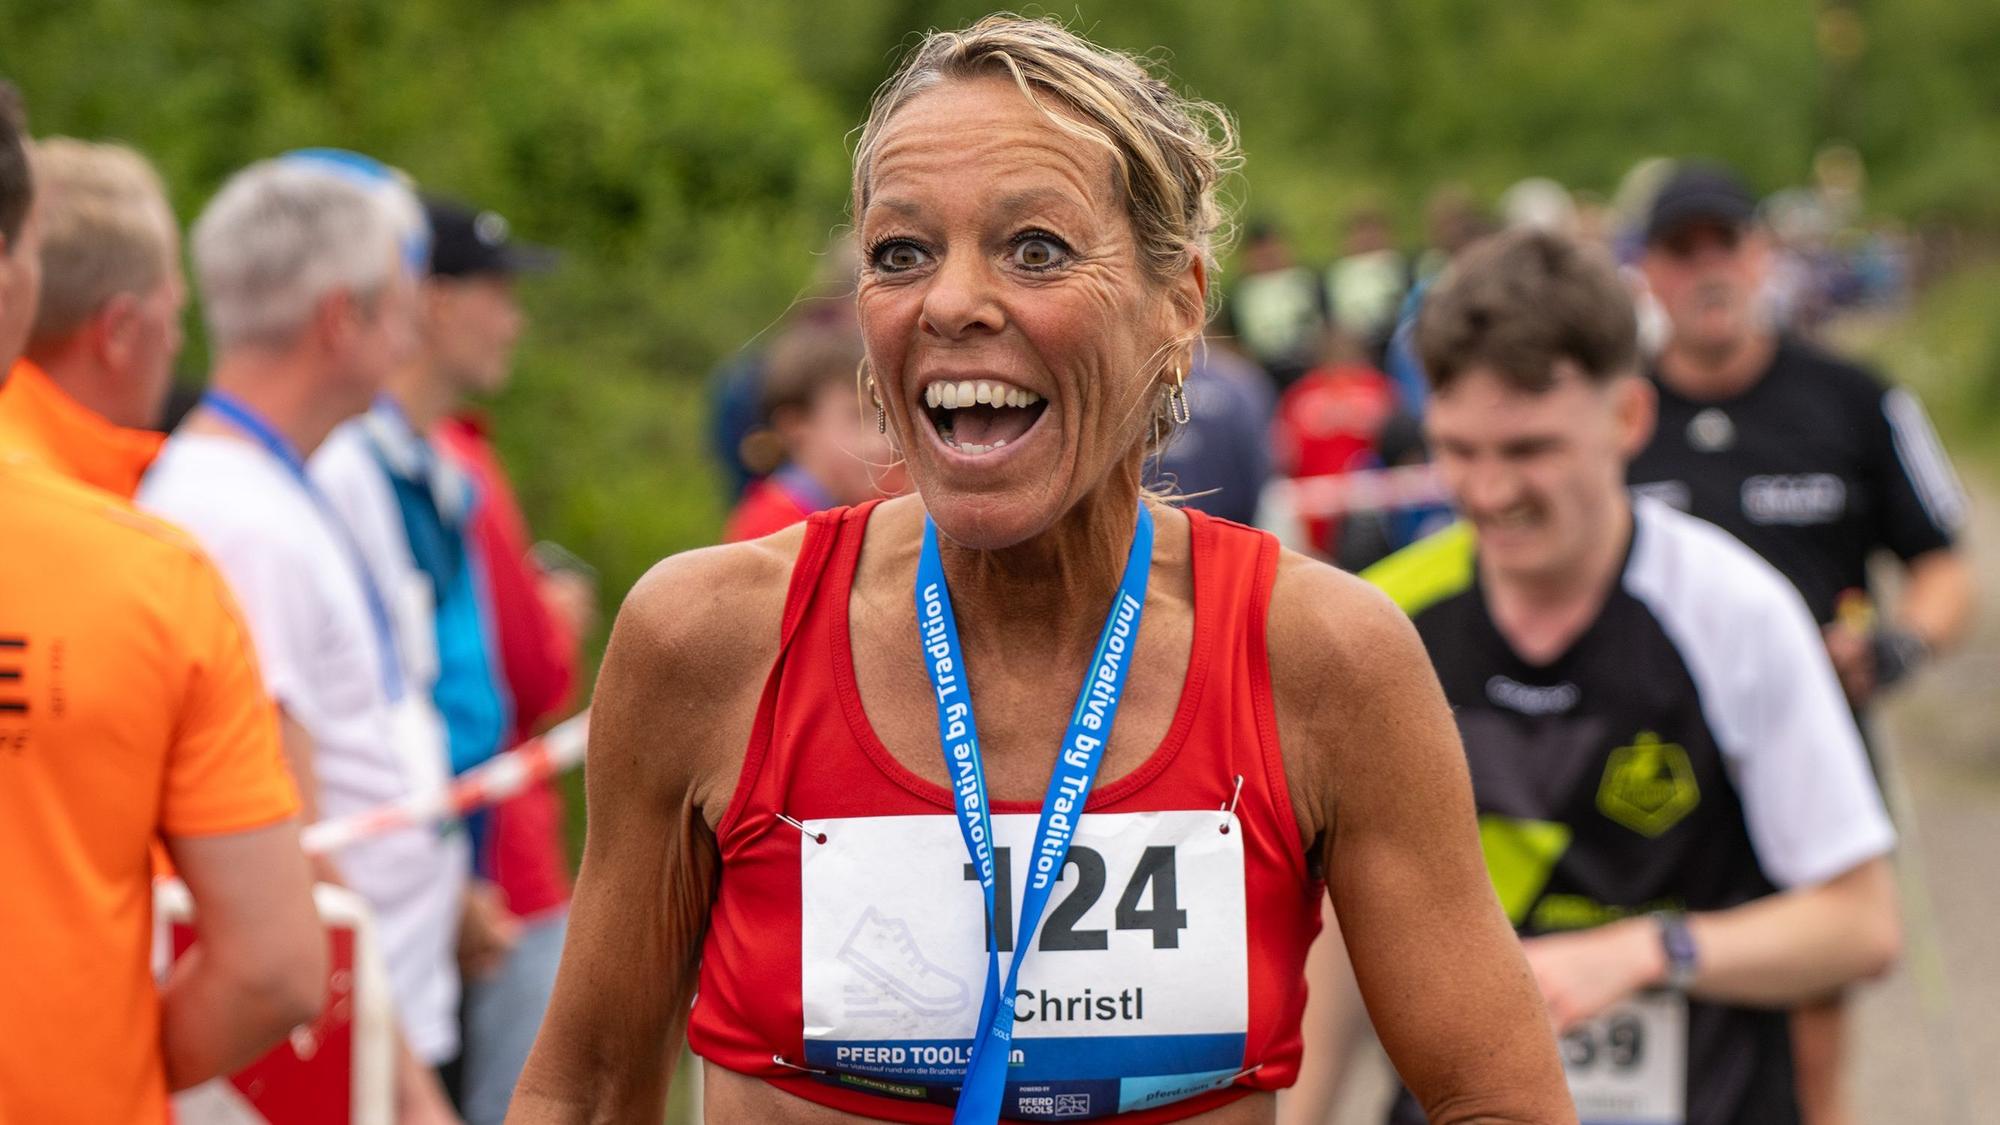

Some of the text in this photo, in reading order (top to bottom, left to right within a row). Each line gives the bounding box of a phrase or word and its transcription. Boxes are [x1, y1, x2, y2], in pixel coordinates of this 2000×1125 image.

[922, 582, 993, 888] Innovative by Tradition
[1033, 594, 1141, 889] Innovative by Tradition
[964, 844, 1187, 953] 124
[1013, 987, 1144, 1022] Christl
[836, 1047, 906, 1064] PFERD
[885, 1066, 903, 1074] rund
[917, 1067, 929, 1075] die
[929, 1067, 968, 1076] Bruchertal
[1018, 1097, 1054, 1106] PFERD
[1019, 1105, 1054, 1115] TOOLS
